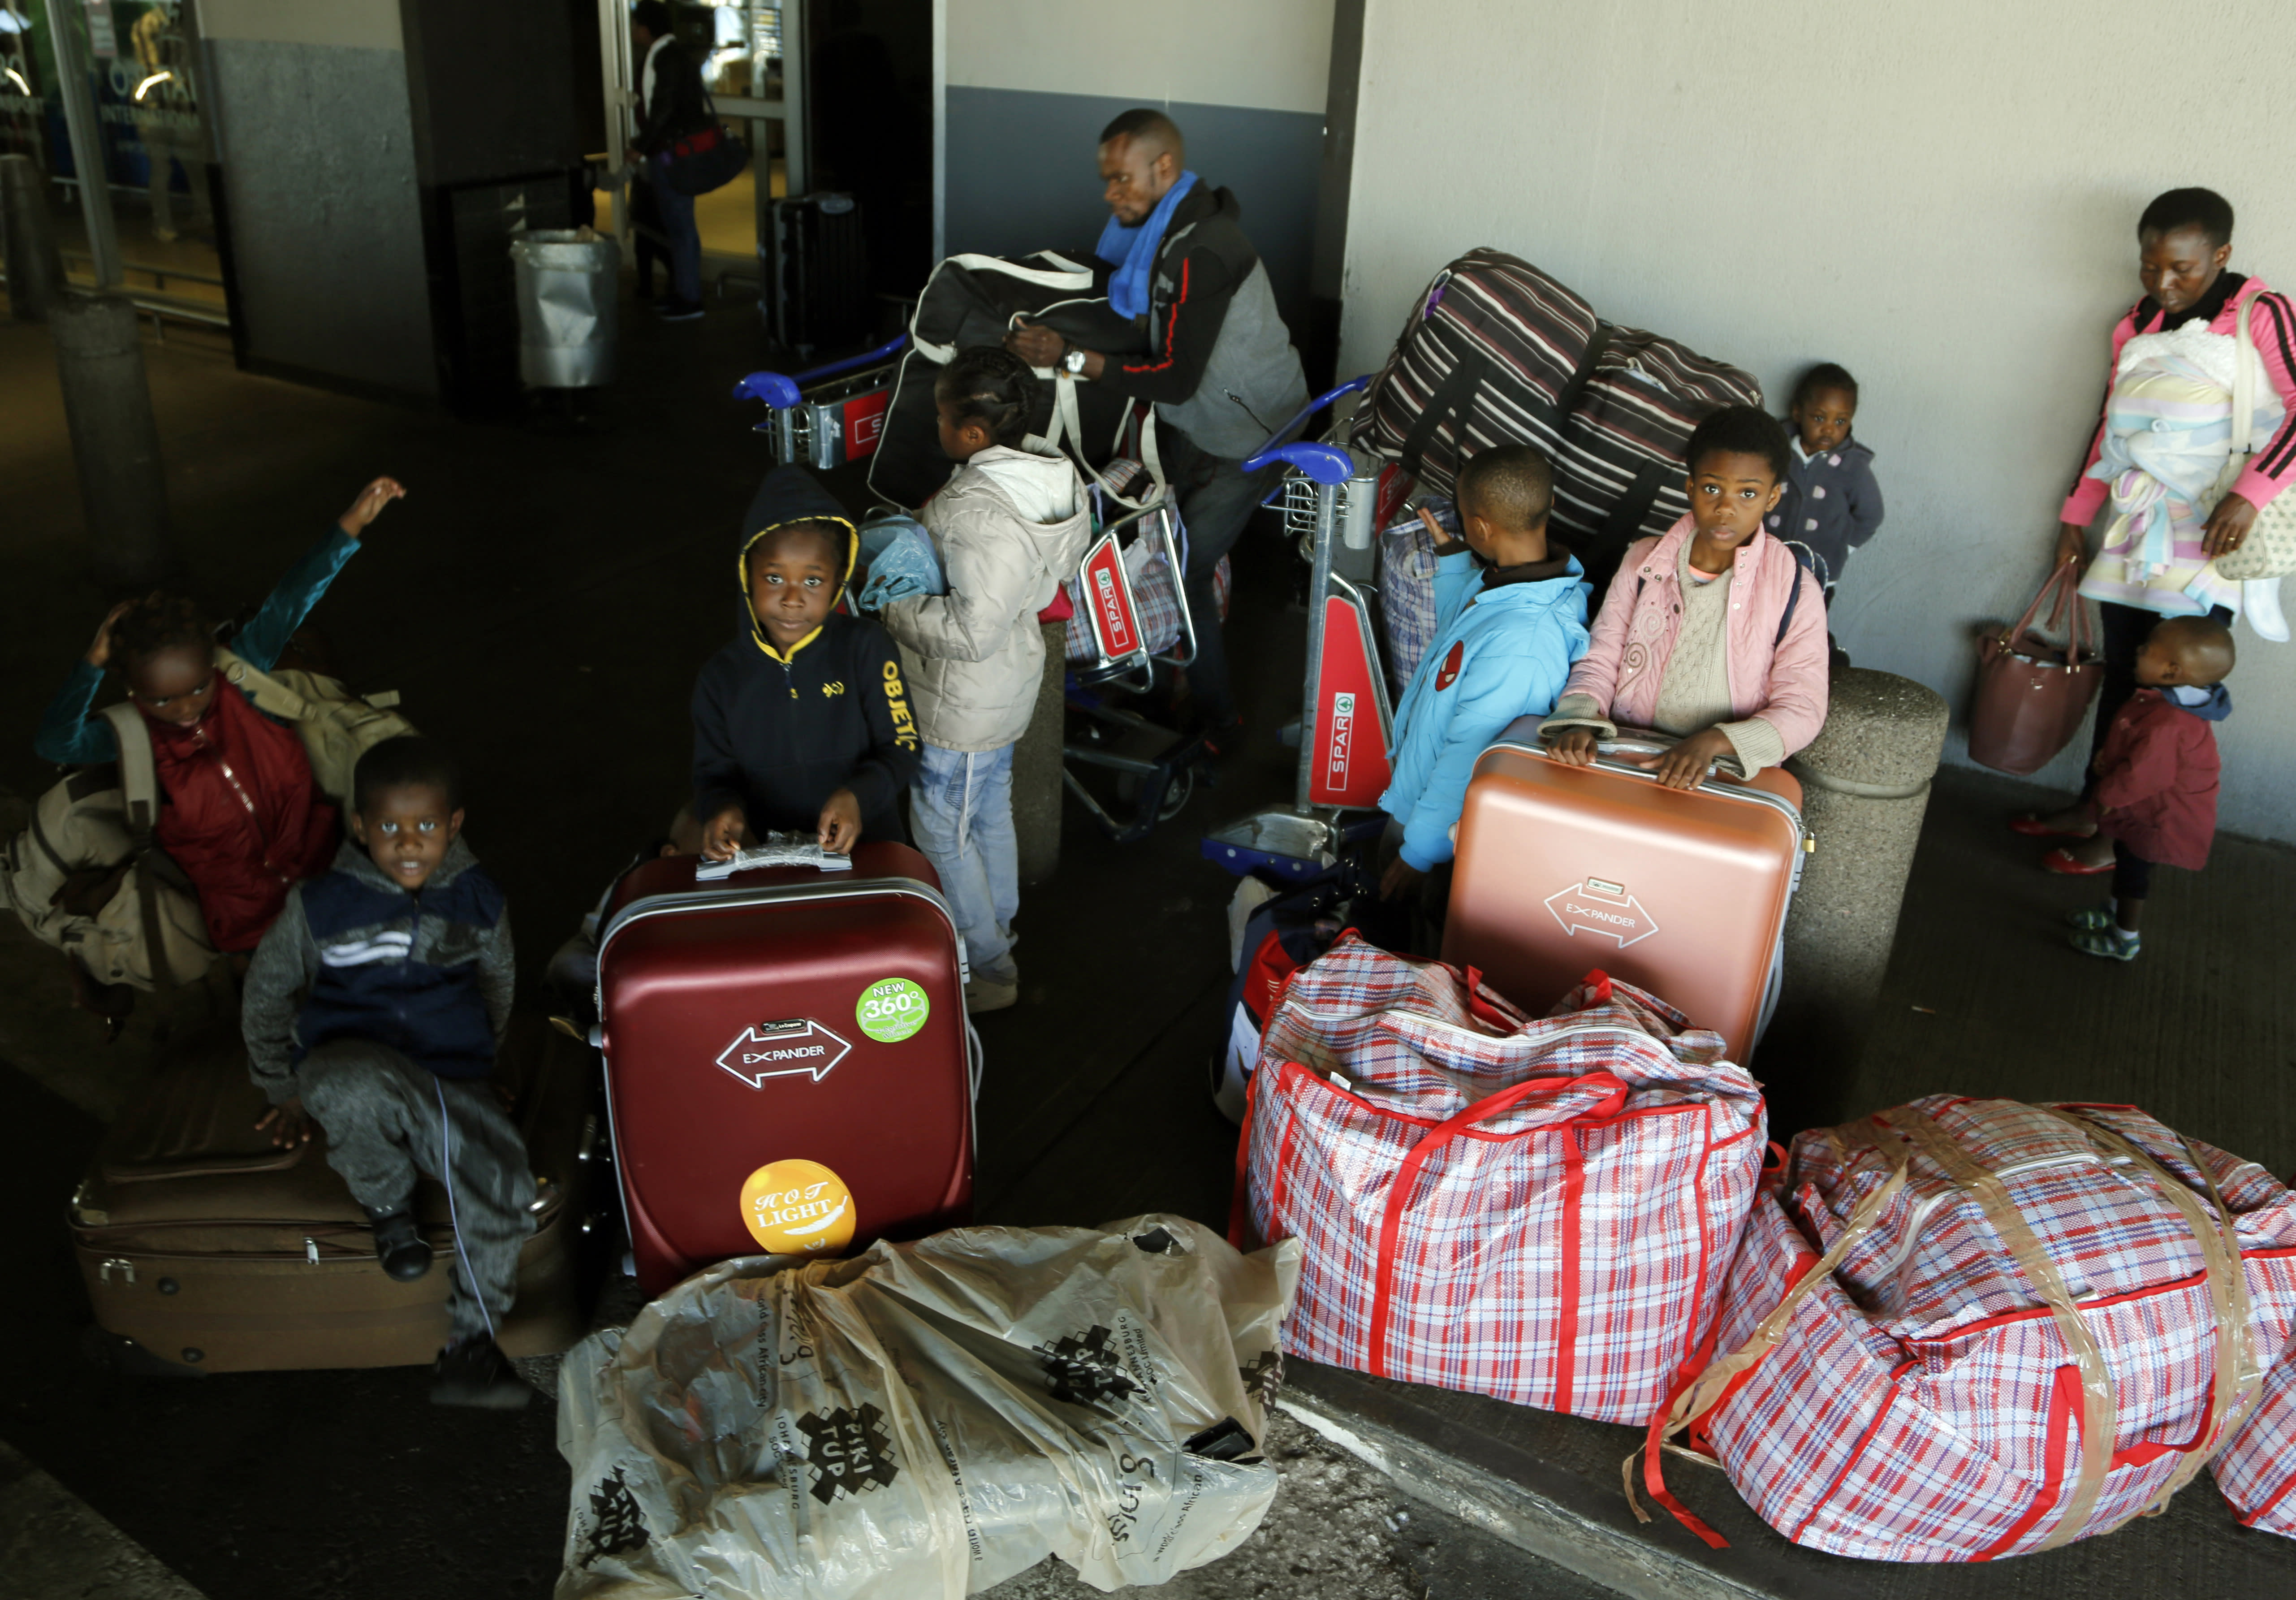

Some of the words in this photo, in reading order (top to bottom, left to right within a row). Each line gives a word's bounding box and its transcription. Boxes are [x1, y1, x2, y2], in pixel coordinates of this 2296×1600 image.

[1102, 587, 1123, 633] SPAR
[1332, 717, 1350, 773] SPAR
[1566, 903, 1636, 928] EXPANDER
[872, 981, 905, 998] NEW
[742, 1045, 825, 1064] EXPANDER
[753, 1181, 829, 1211] HOT
[755, 1198, 832, 1228] LIGHT
[768, 1436, 782, 1459] SOC
[820, 1426, 846, 1476] TUP
[845, 1423, 873, 1474] PIKI
[1182, 1474, 1203, 1512] African
